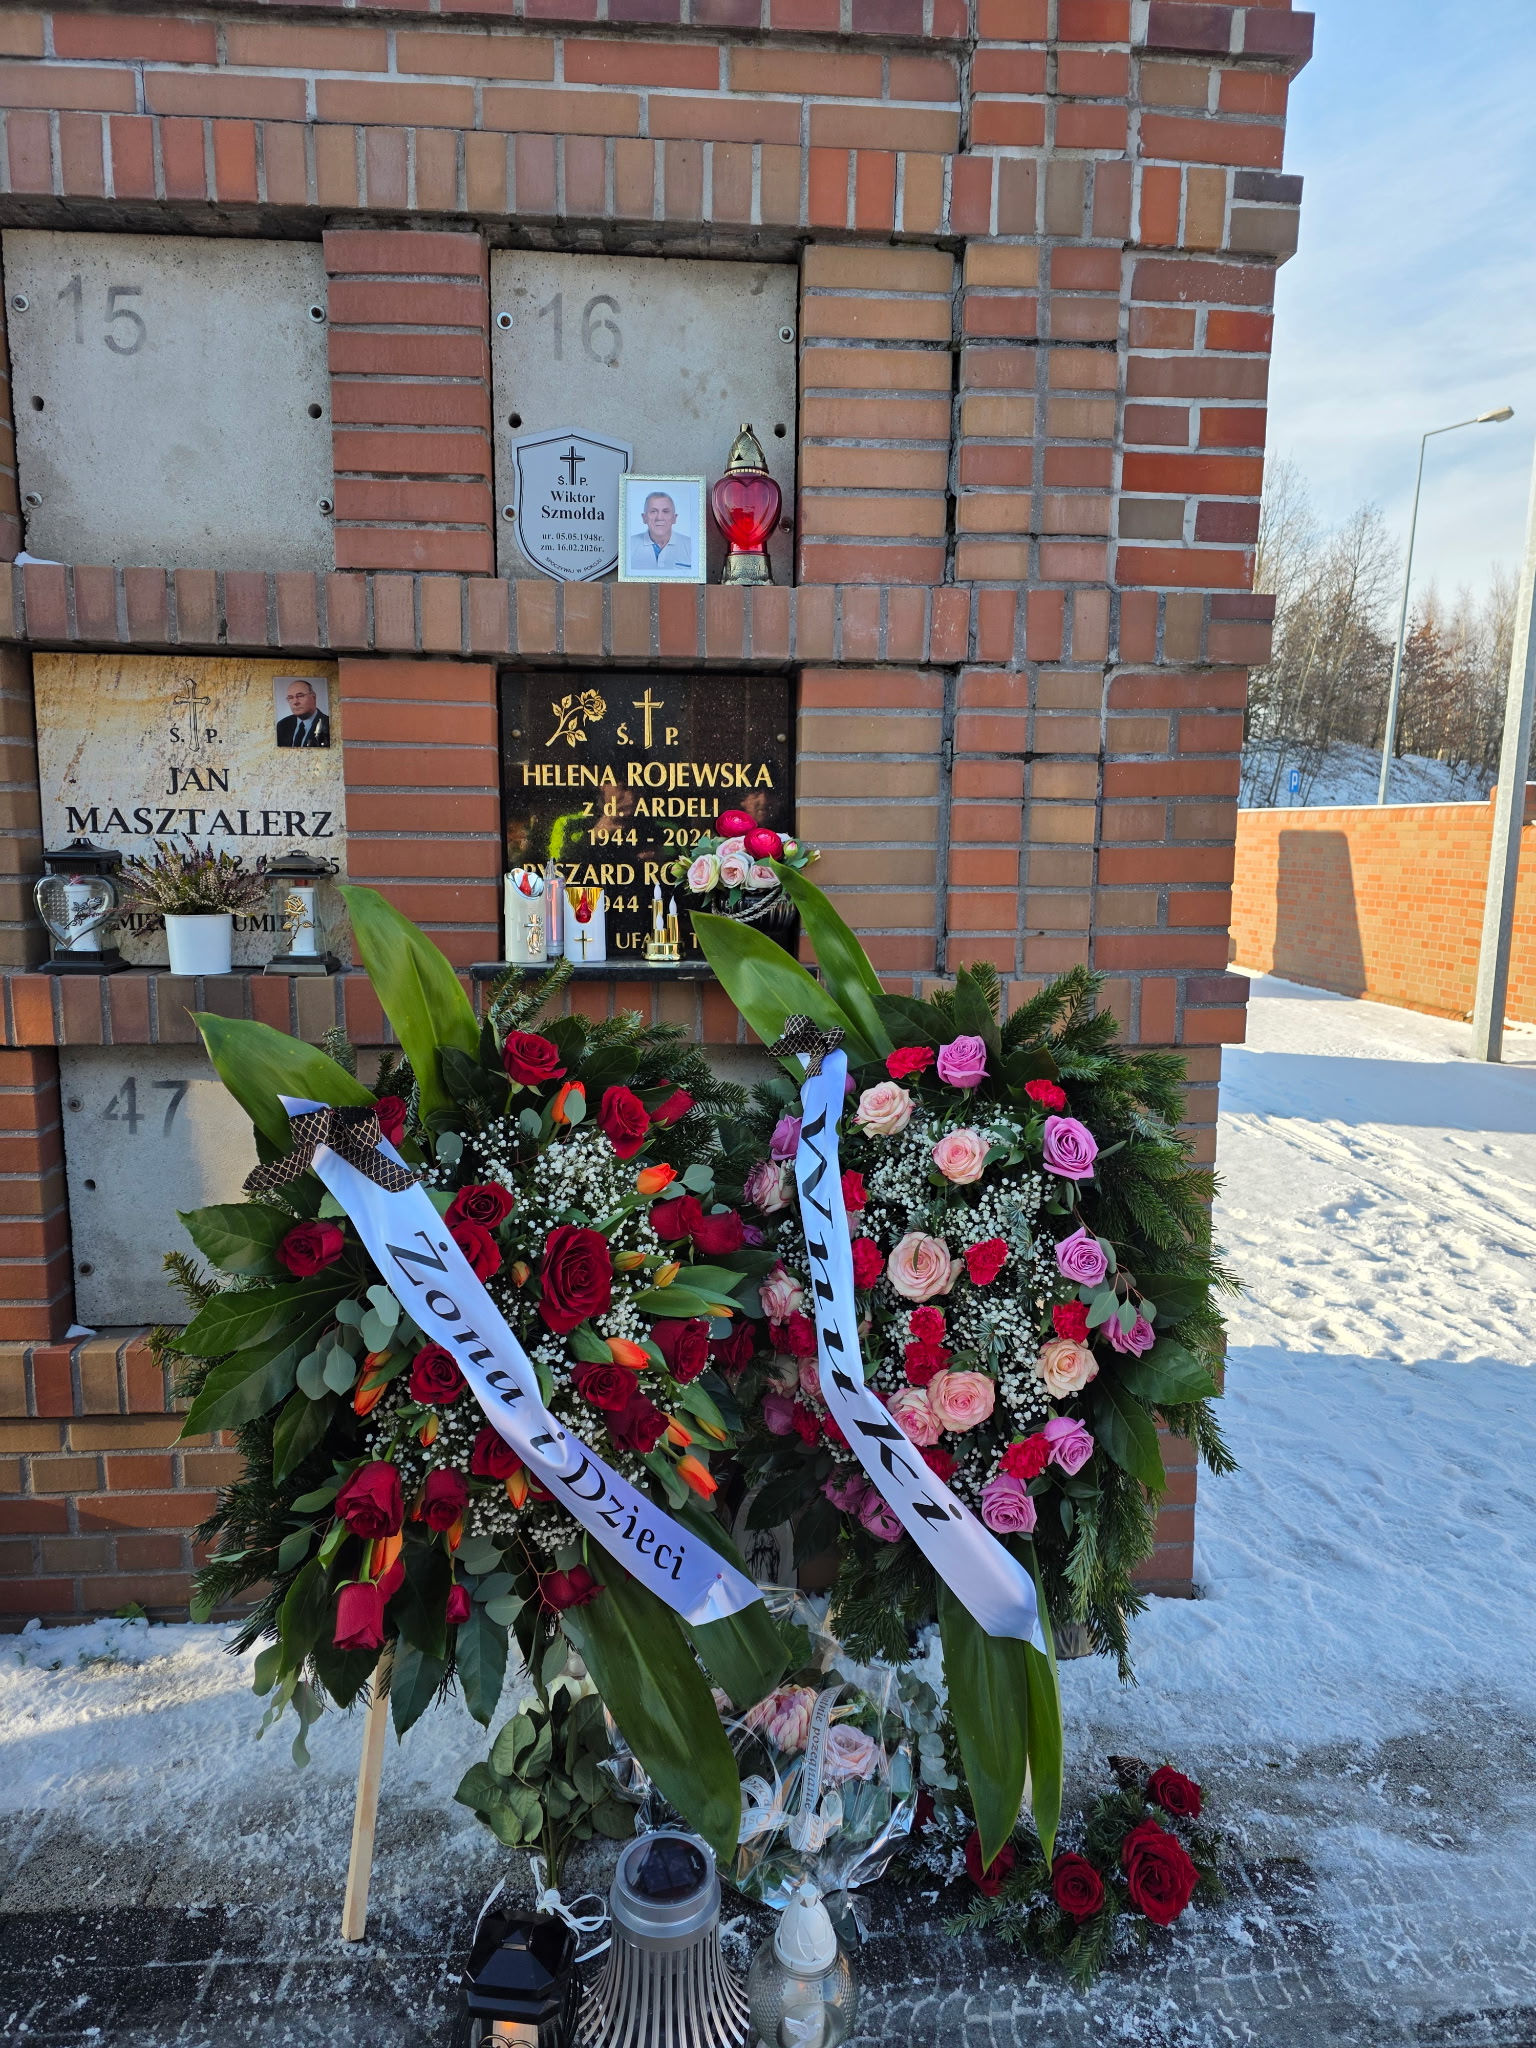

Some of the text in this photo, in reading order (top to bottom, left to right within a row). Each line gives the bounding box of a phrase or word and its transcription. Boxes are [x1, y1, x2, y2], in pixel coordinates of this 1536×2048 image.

[58, 274, 147, 356] 15
[538, 291, 624, 365] 16
[557, 475, 588, 486] Ś. P.
[550, 490, 596, 503] Wiktor
[541, 504, 605, 521] Szmołda
[556, 532, 605, 542] 05.05.1948r.
[557, 543, 605, 553] 16.02.2026r.
[169, 723, 223, 744] Ś. P.
[616, 723, 679, 746] Ś. P.
[166, 767, 230, 796] JAN
[522, 761, 774, 792] HELENA ROJEWSKA
[582, 795, 719, 818] z d. ARDELI
[65, 806, 334, 838] MASZTALERZ
[587, 828, 639, 847] 1944
[615, 931, 648, 950] UFA
[102, 1076, 191, 1138] 47
[800, 1103, 964, 1534] Wnuki
[384, 1229, 687, 1582] Żona i Dzieci
